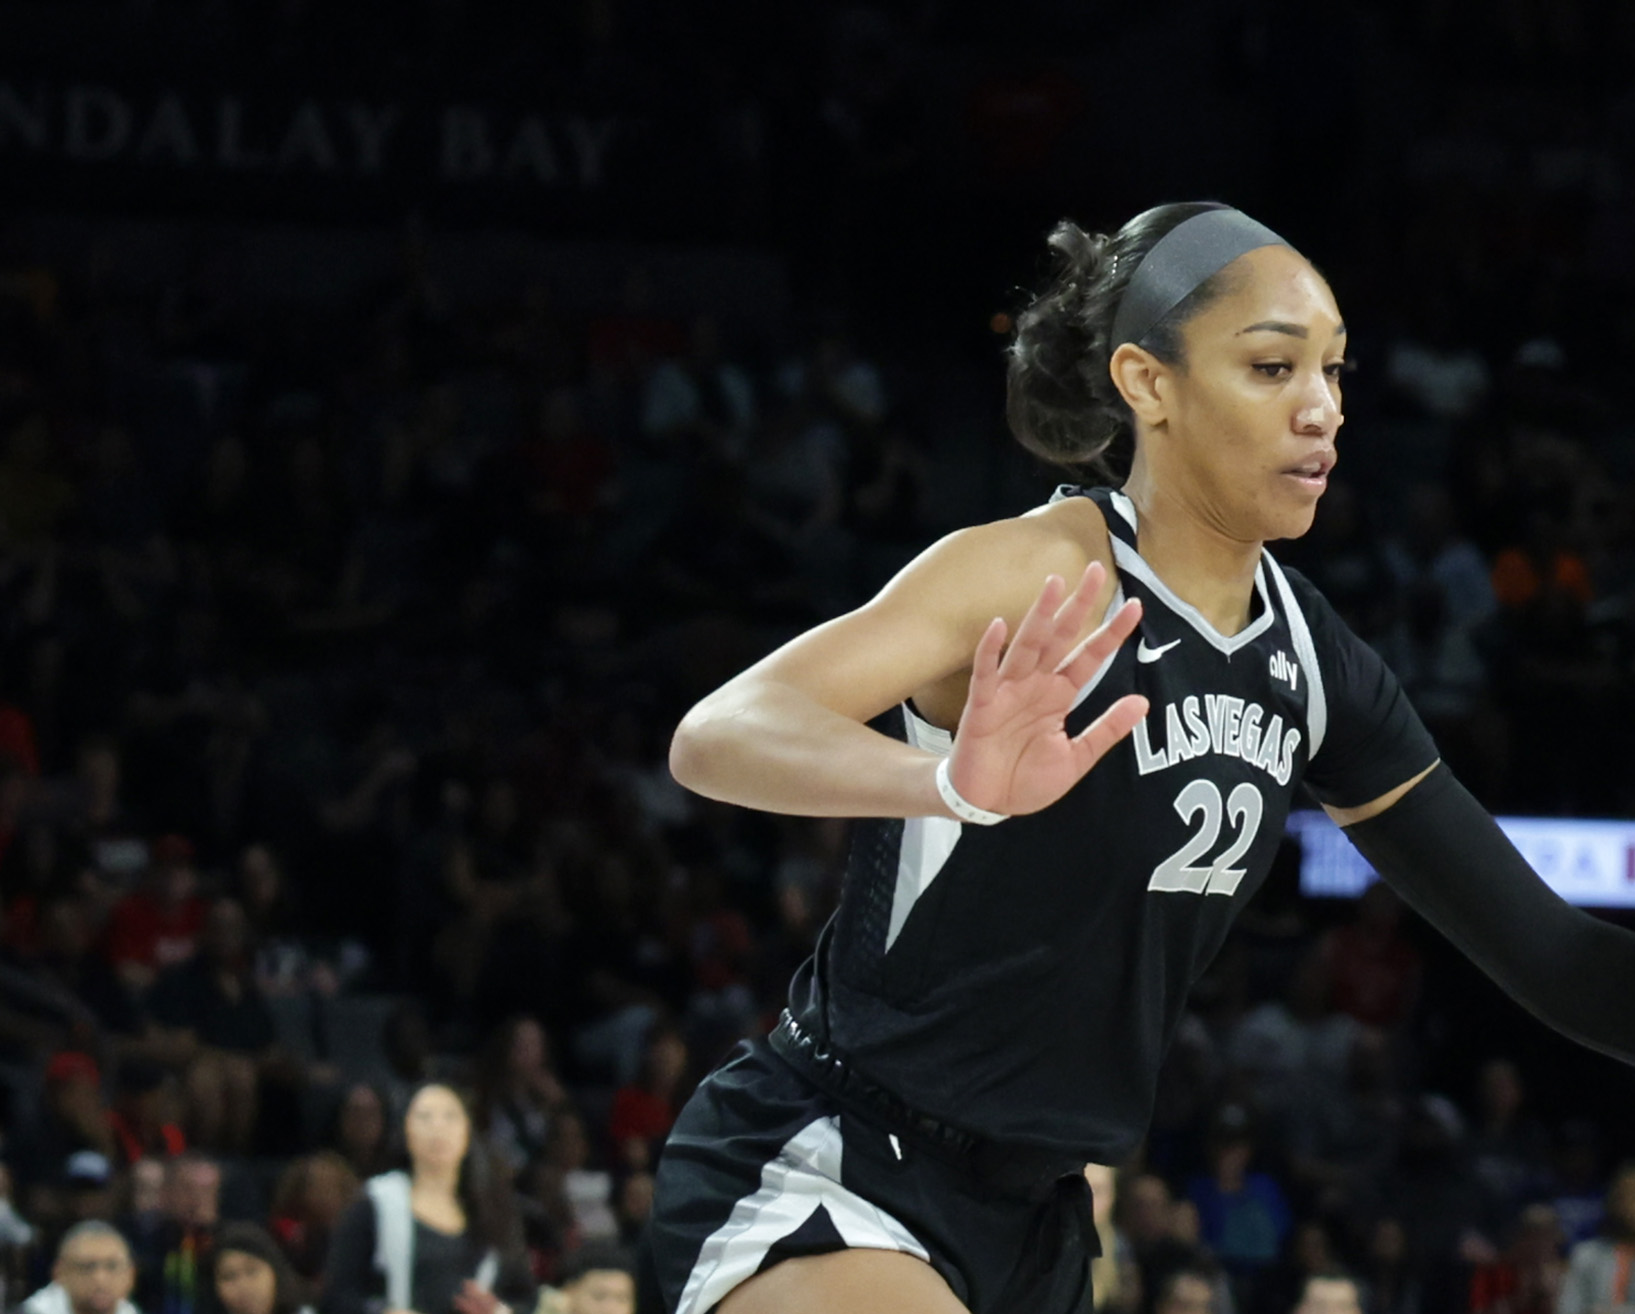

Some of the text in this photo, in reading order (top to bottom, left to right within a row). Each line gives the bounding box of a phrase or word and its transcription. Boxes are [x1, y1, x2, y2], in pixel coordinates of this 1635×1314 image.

[437, 104, 617, 190] BAY
[1269, 650, 1298, 691] ally
[1147, 778, 1264, 897] 22
